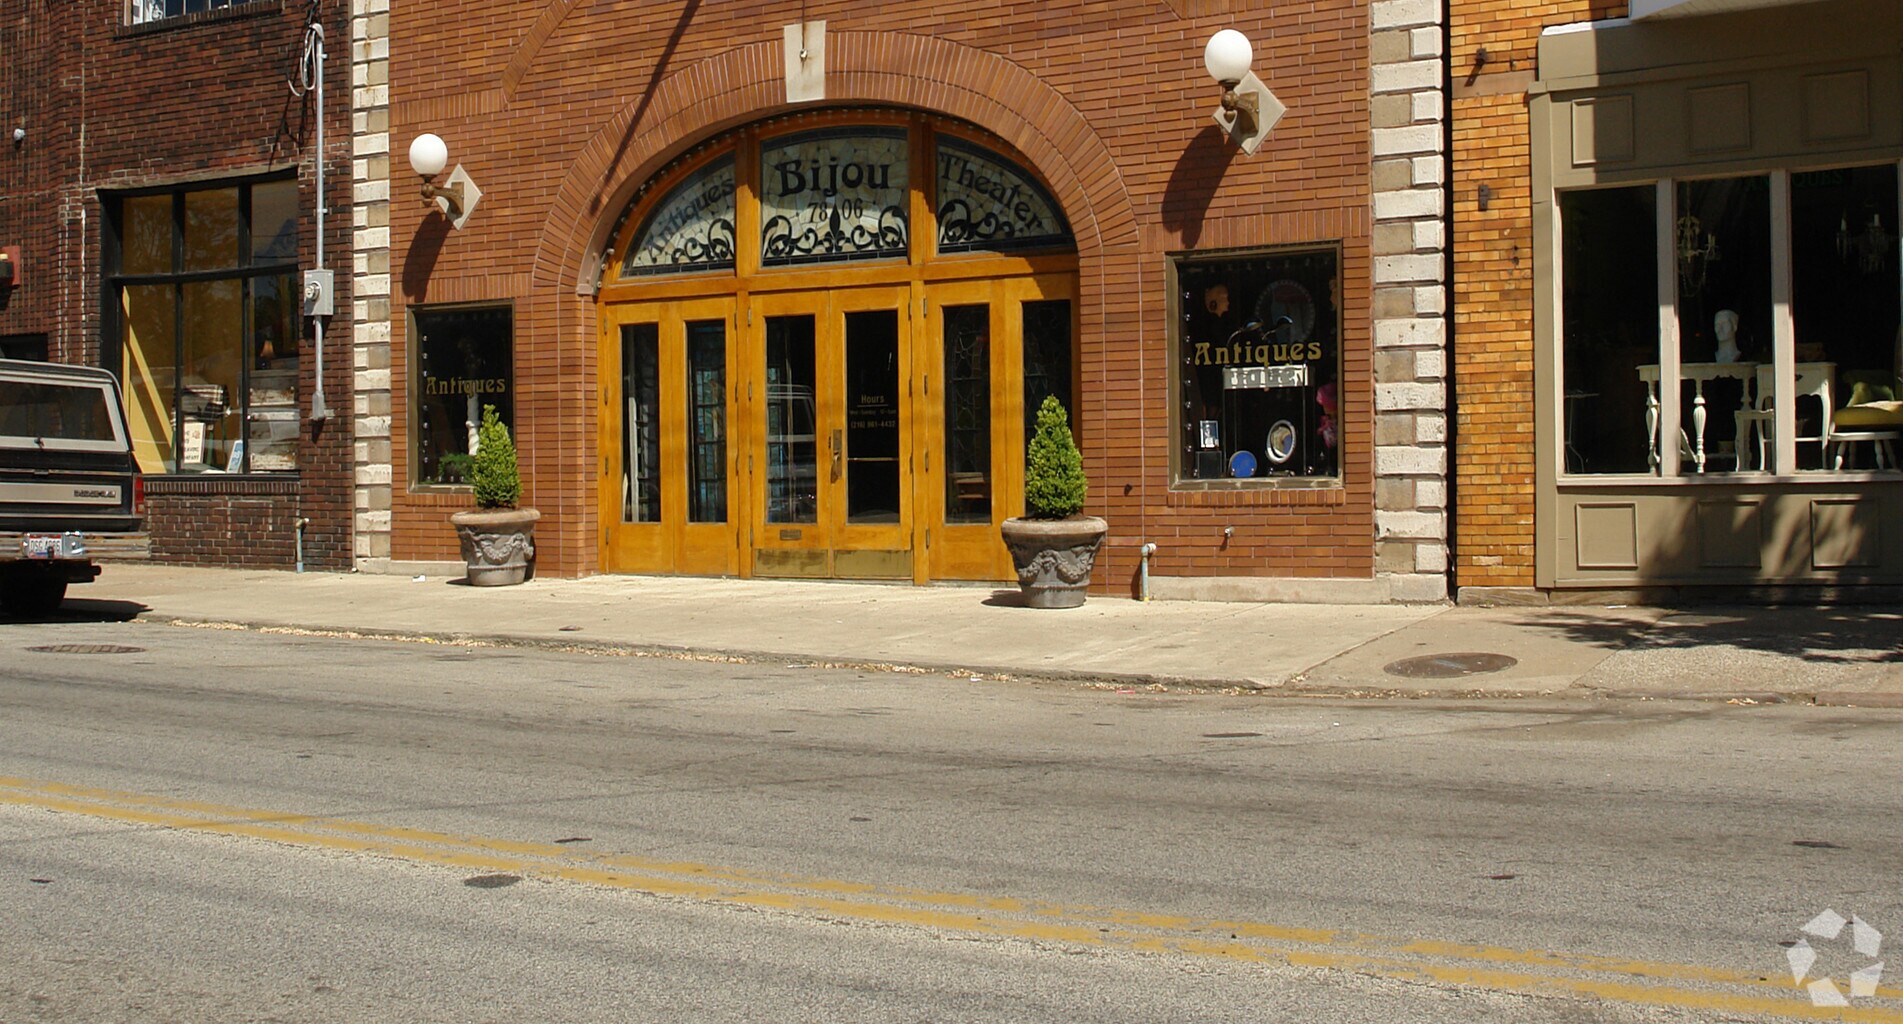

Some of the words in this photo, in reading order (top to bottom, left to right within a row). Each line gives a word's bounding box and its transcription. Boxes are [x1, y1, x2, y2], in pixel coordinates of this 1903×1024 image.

[774, 157, 890, 197] Bijou
[938, 152, 1043, 230] Theater
[645, 178, 735, 264] Antiques
[807, 201, 828, 223] 78
[842, 198, 863, 220] 06
[1194, 341, 1322, 367] Antiques
[426, 377, 506, 397] Antiques
[861, 394, 885, 404] Hours
